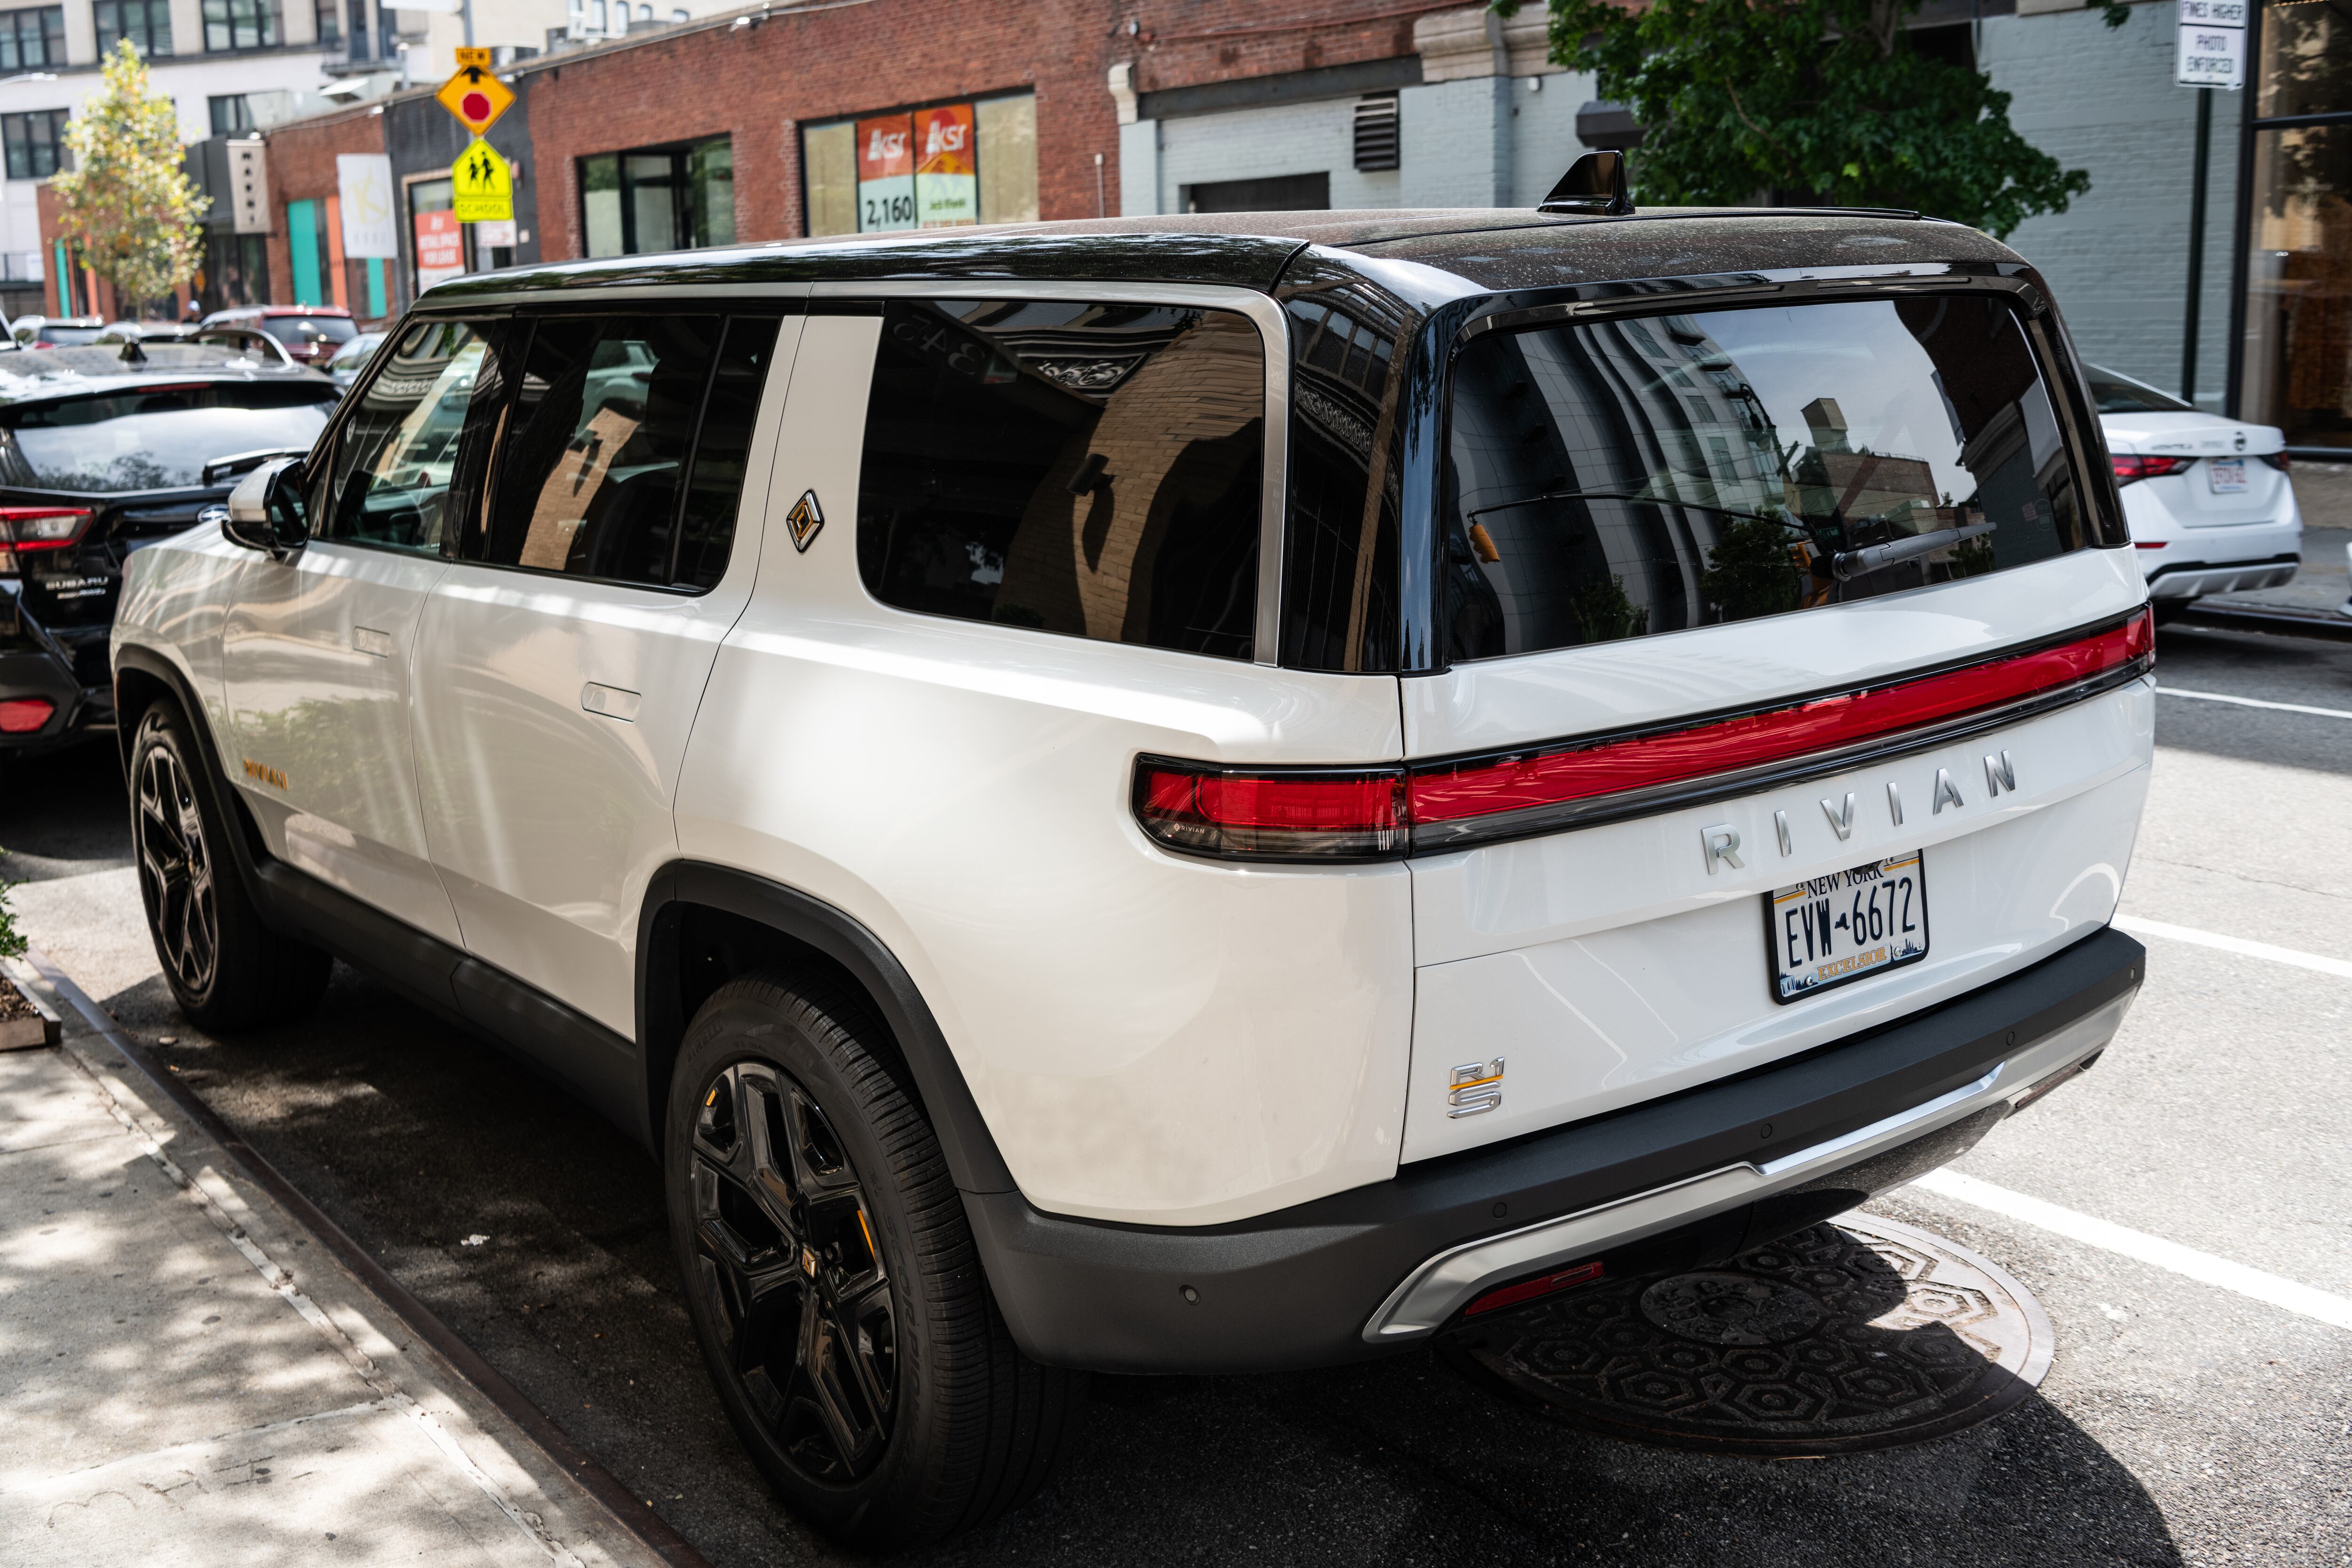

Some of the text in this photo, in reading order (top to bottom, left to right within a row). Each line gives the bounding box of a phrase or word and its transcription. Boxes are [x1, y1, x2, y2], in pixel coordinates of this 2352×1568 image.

[2196, 34, 2227, 51] PHOTO
[460, 51, 485, 62] NEW
[2186, 56, 2234, 73] ENFORCED
[460, 203, 506, 215] SCHOOL
[866, 196, 912, 229] 2,160
[46, 576, 109, 590] SUBARU
[243, 757, 288, 791] RIVIAN
[1701, 750, 2016, 874] RIVIAN
[1806, 872, 1841, 899] NEW
[1817, 947, 1887, 981] EXCELSIOR
